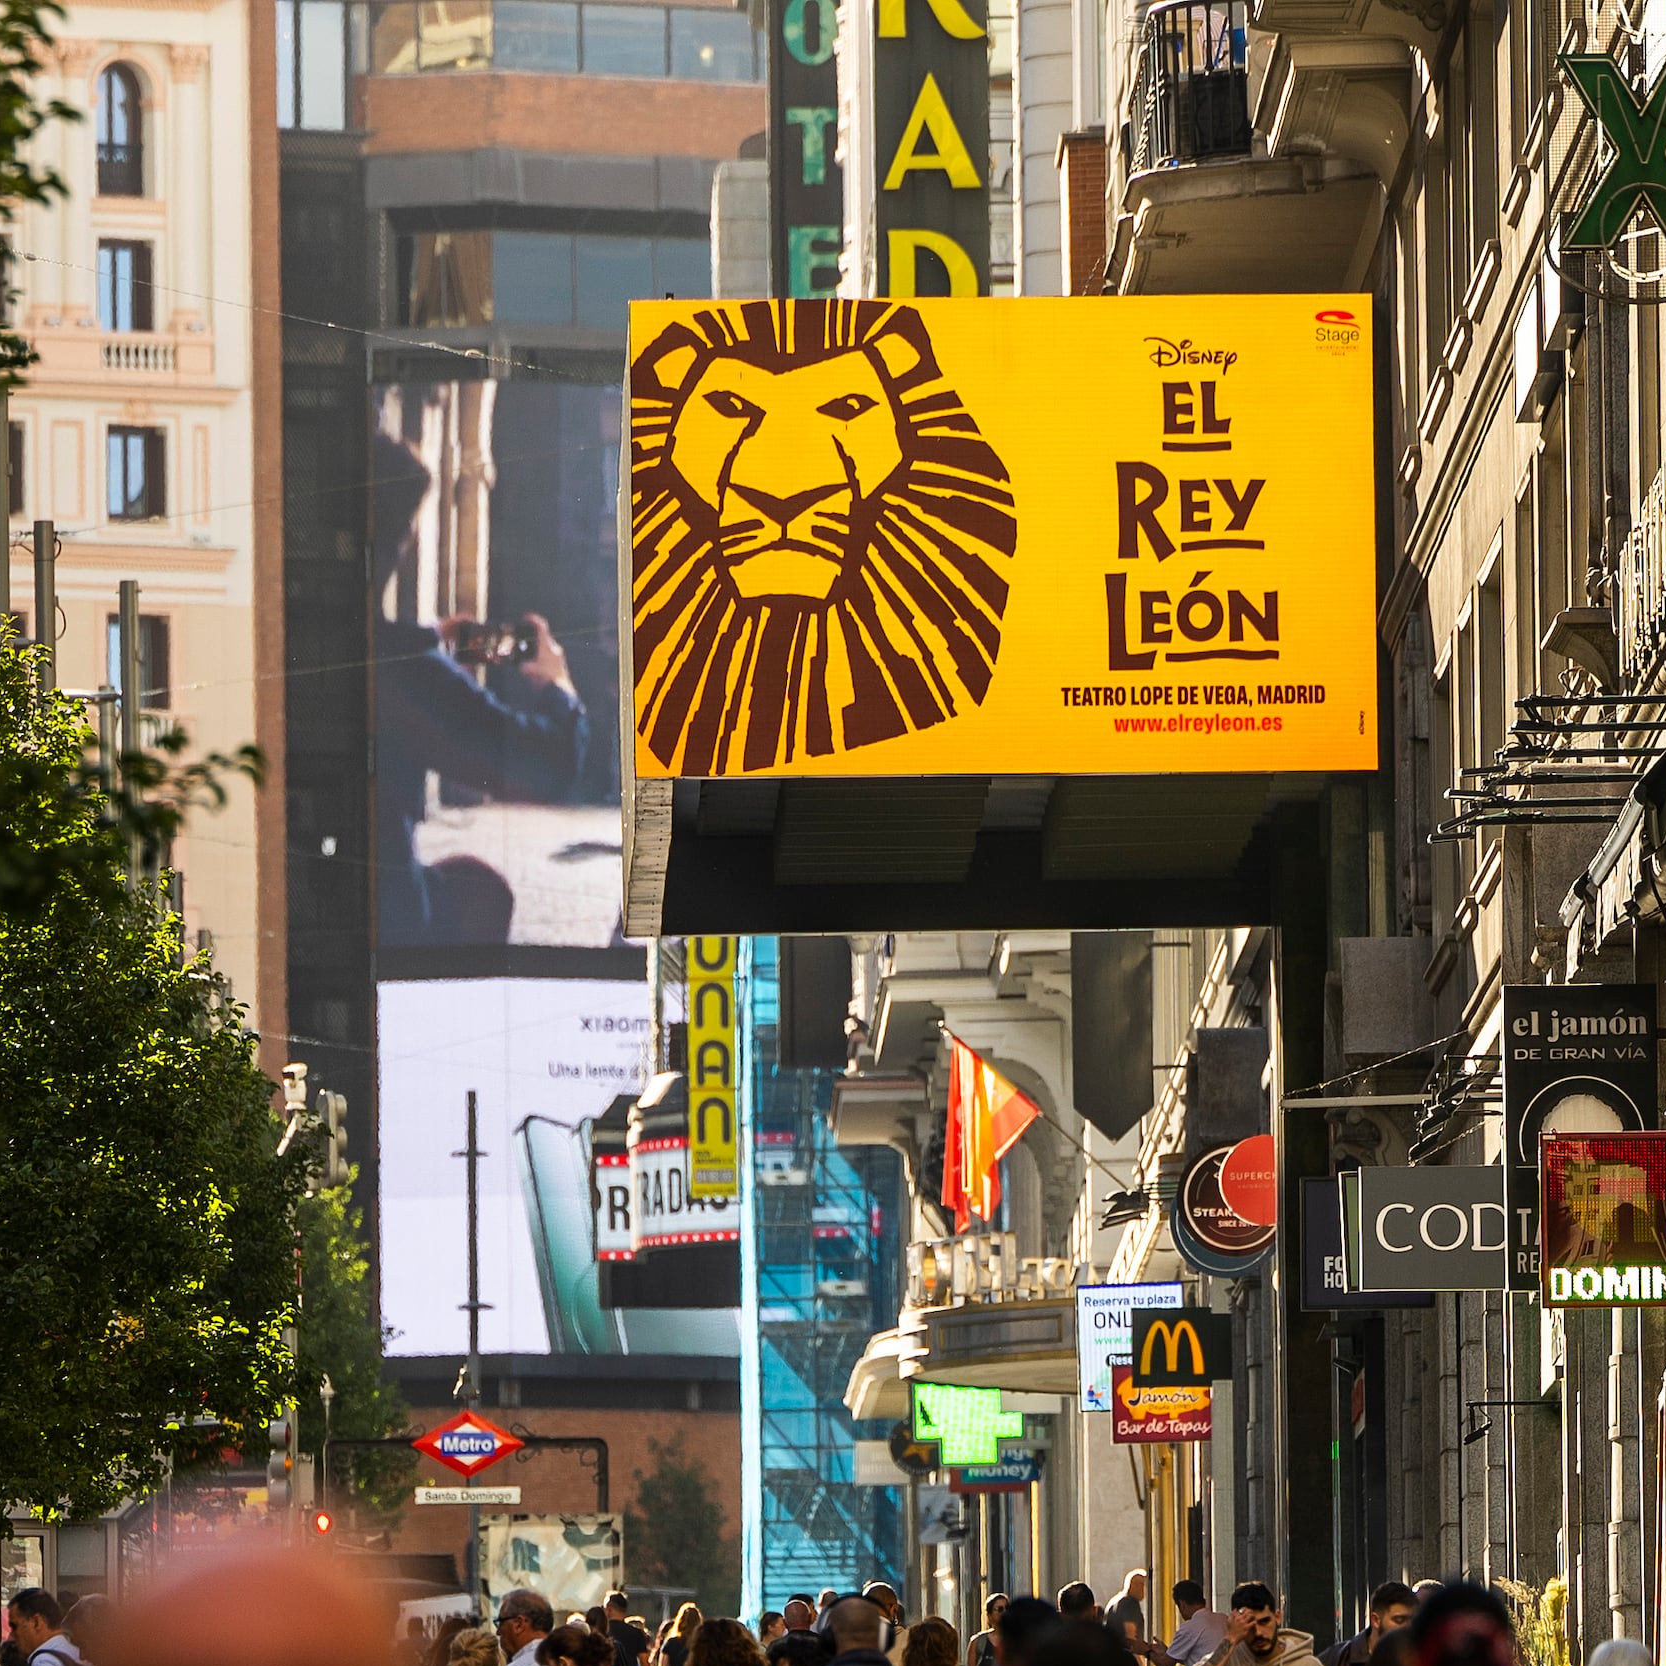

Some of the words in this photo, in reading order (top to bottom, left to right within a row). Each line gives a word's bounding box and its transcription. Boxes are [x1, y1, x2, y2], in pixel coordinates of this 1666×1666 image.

[1315, 327, 1359, 344] Stage
[1144, 336, 1237, 376] Disney
[1162, 381, 1231, 435] EL
[1061, 687, 1126, 707] TEATRO
[1130, 687, 1174, 706] LOPE
[1178, 686, 1199, 705] DE
[1203, 685, 1253, 707] VEGA,
[1258, 685, 1325, 705] MADRID
[1114, 713, 1282, 734] www.elreyleon.es
[1512, 1011, 1540, 1036] el
[1546, 1008, 1648, 1043] jamón
[1514, 1048, 1542, 1060] DE
[1549, 1047, 1606, 1060] GRAN
[1614, 1042, 1647, 1058] VÍA
[1084, 1296, 1130, 1307] Reserva
[1133, 1296, 1145, 1306] tu
[1147, 1294, 1177, 1308] plaza
[1117, 1420, 1145, 1435] Bar
[1145, 1418, 1166, 1433] de
[1166, 1418, 1212, 1436] Tapas
[443, 1436, 493, 1452] Metro
[425, 1491, 457, 1501] Santo
[461, 1491, 512, 1503] Domingo
